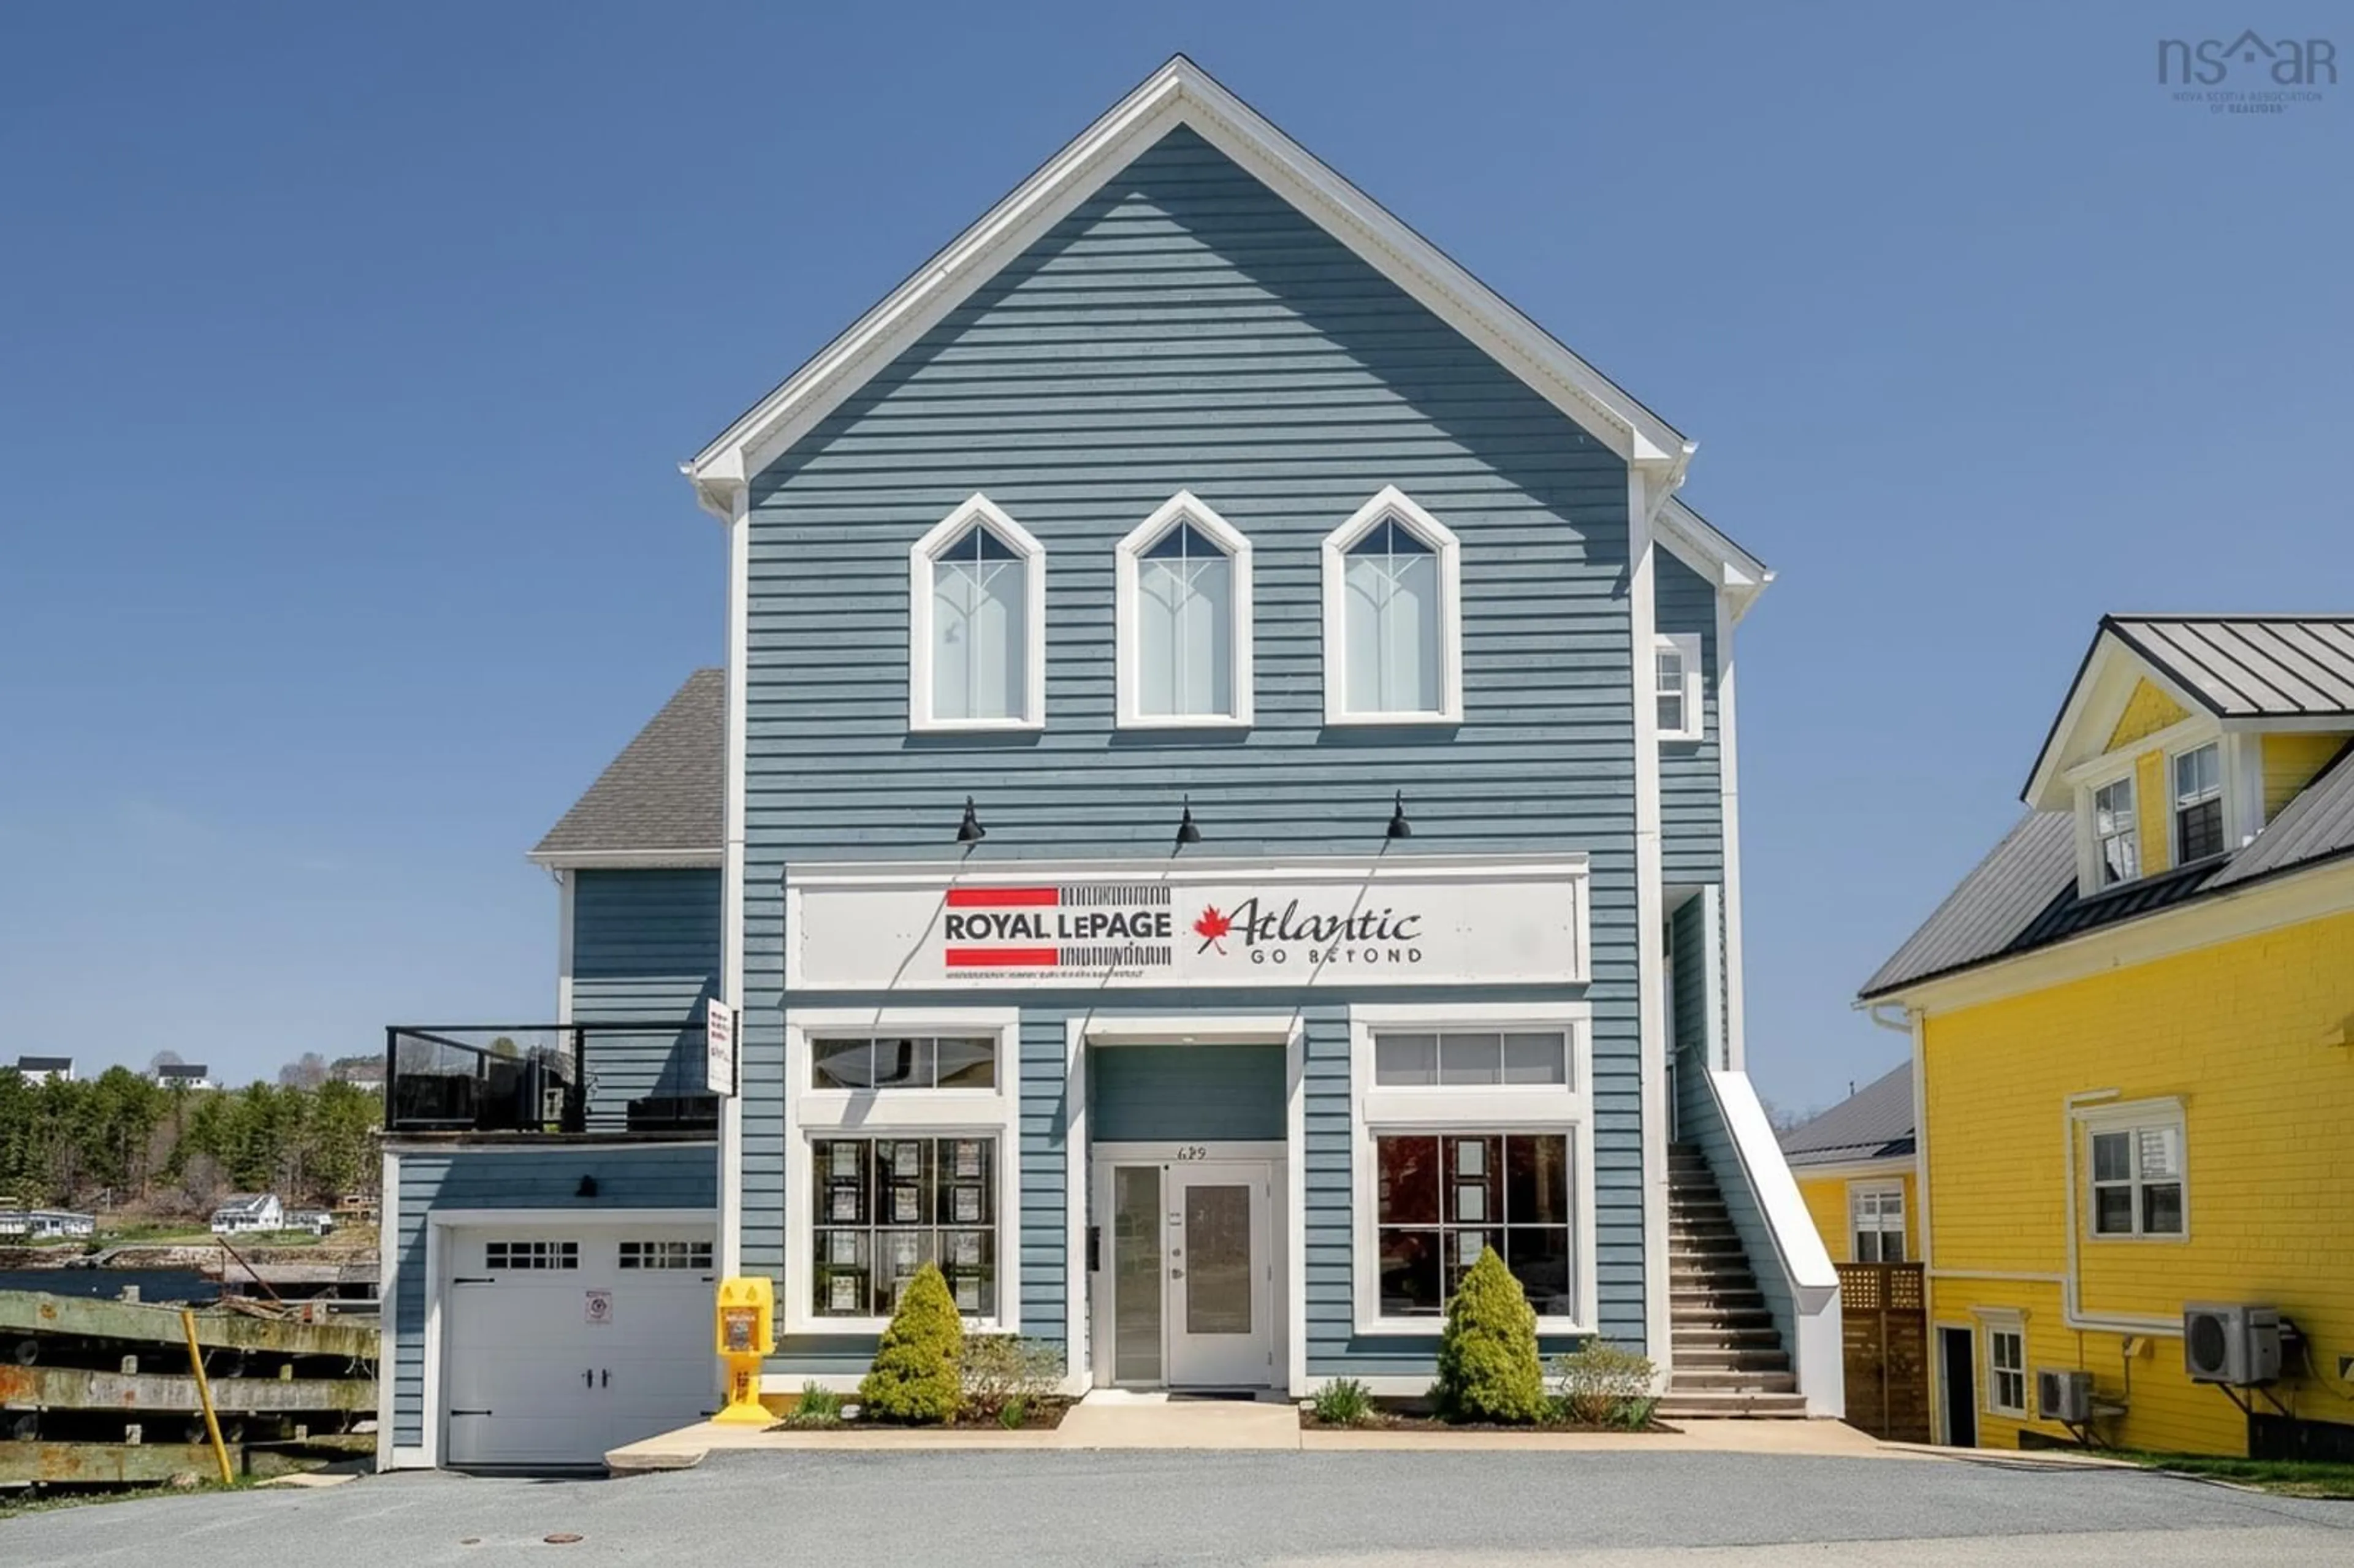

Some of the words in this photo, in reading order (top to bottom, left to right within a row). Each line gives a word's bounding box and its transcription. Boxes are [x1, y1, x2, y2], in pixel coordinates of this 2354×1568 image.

[945, 913, 1052, 940] ROYAL
[1227, 897, 1422, 946] Atlantic
[1251, 948, 1287, 964] GO
